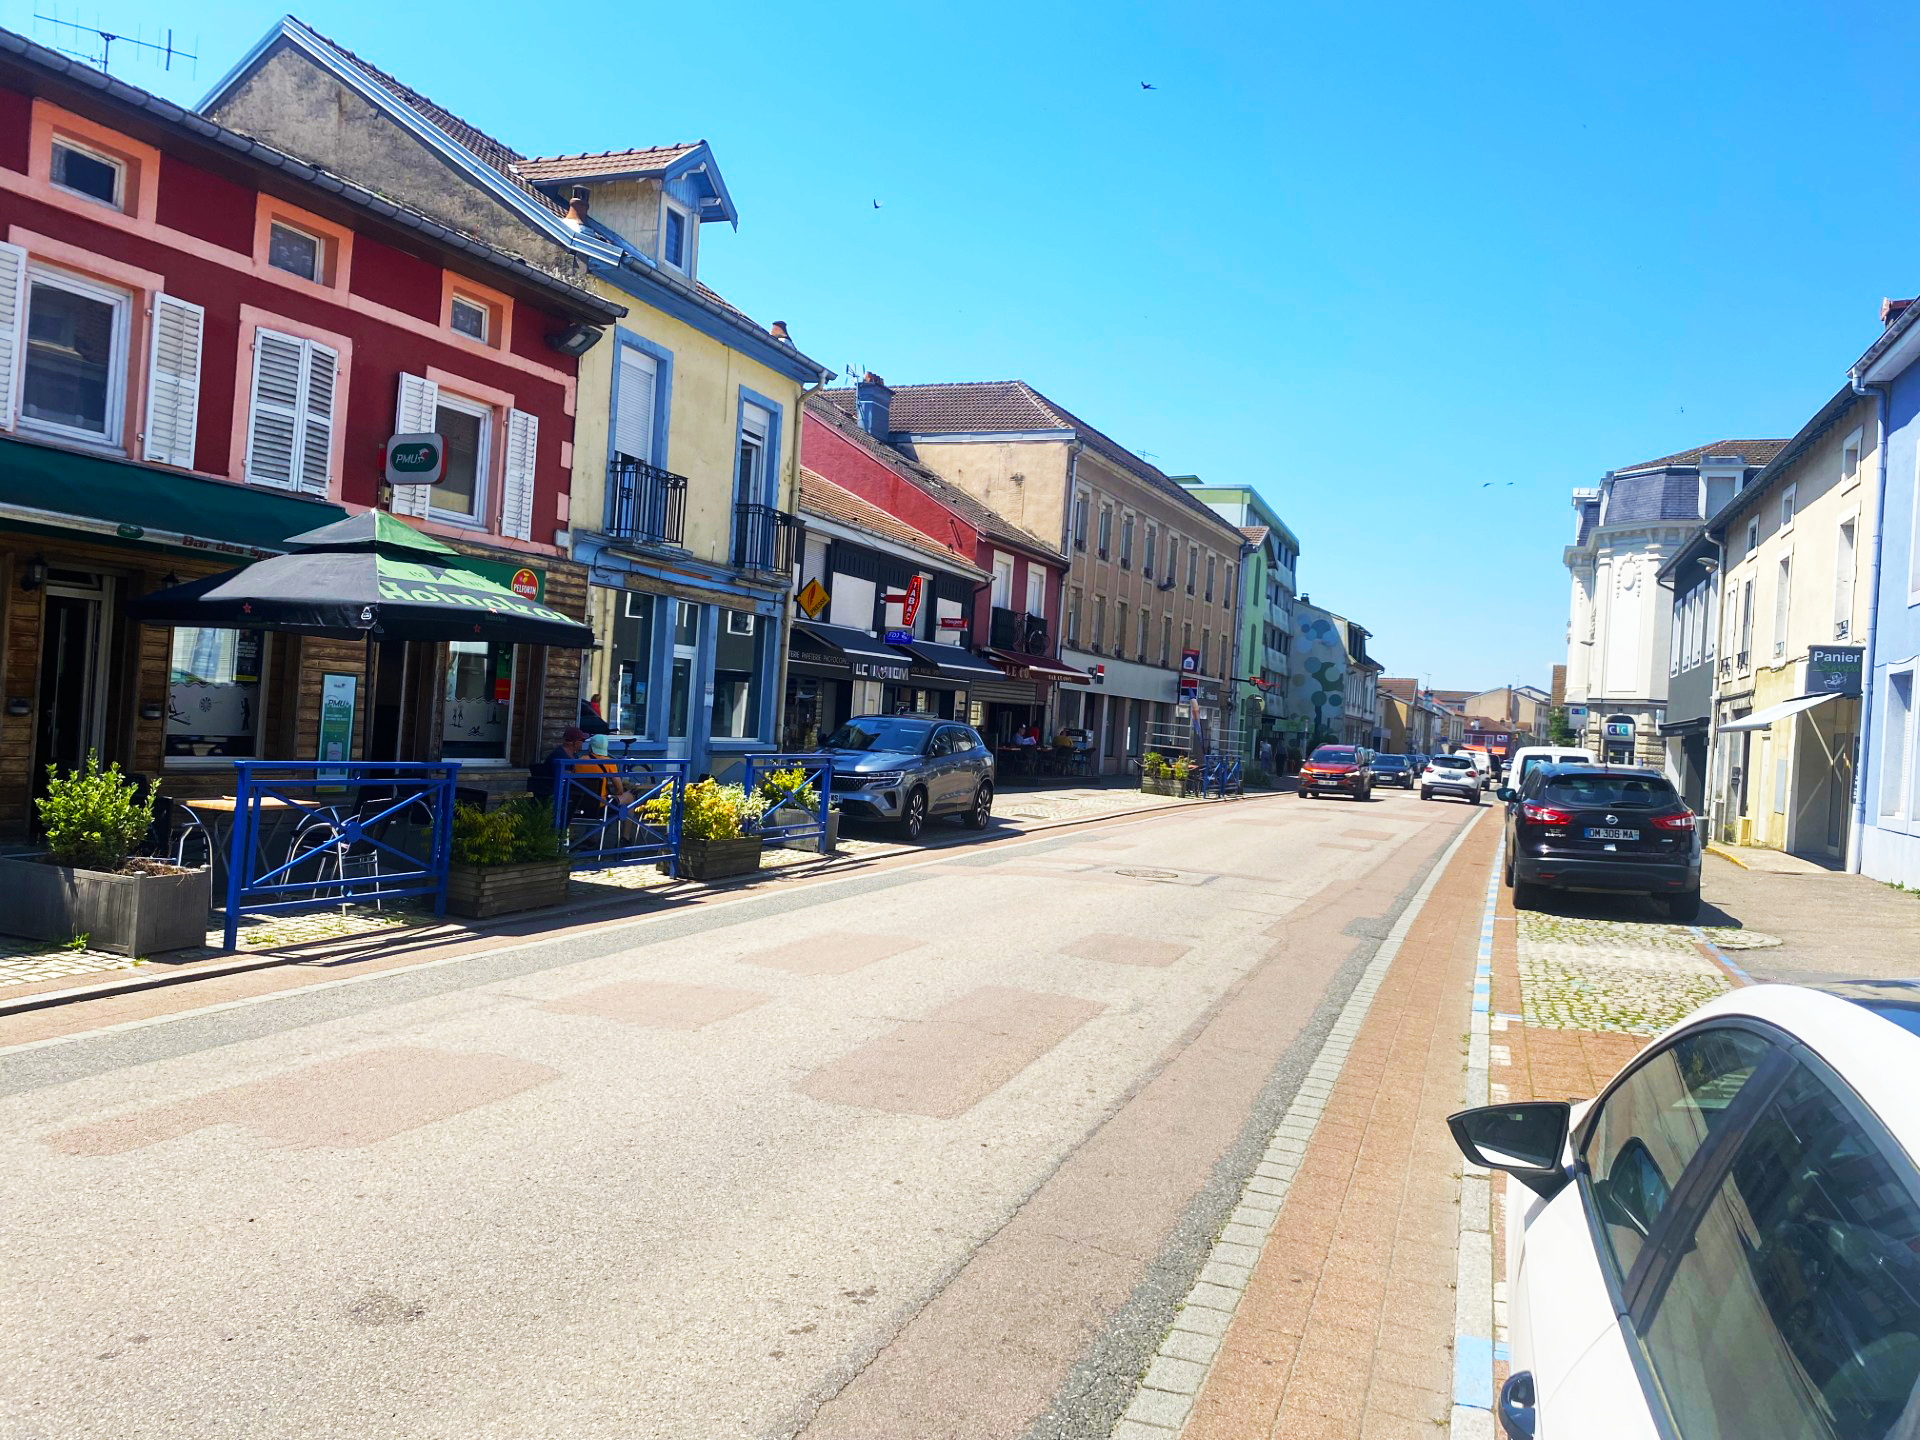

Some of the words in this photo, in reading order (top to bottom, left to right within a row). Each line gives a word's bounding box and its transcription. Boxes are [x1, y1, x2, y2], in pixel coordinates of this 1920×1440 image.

[395, 454, 418, 464] PMU
[182, 535, 208, 550] Bar
[216, 542, 244, 555] des
[810, 596, 827, 614] PRESSE
[906, 582, 918, 621] TABAC
[1813, 651, 1860, 663] Panier
[328, 699, 346, 707] PMU
[1608, 725, 1627, 736] CIC
